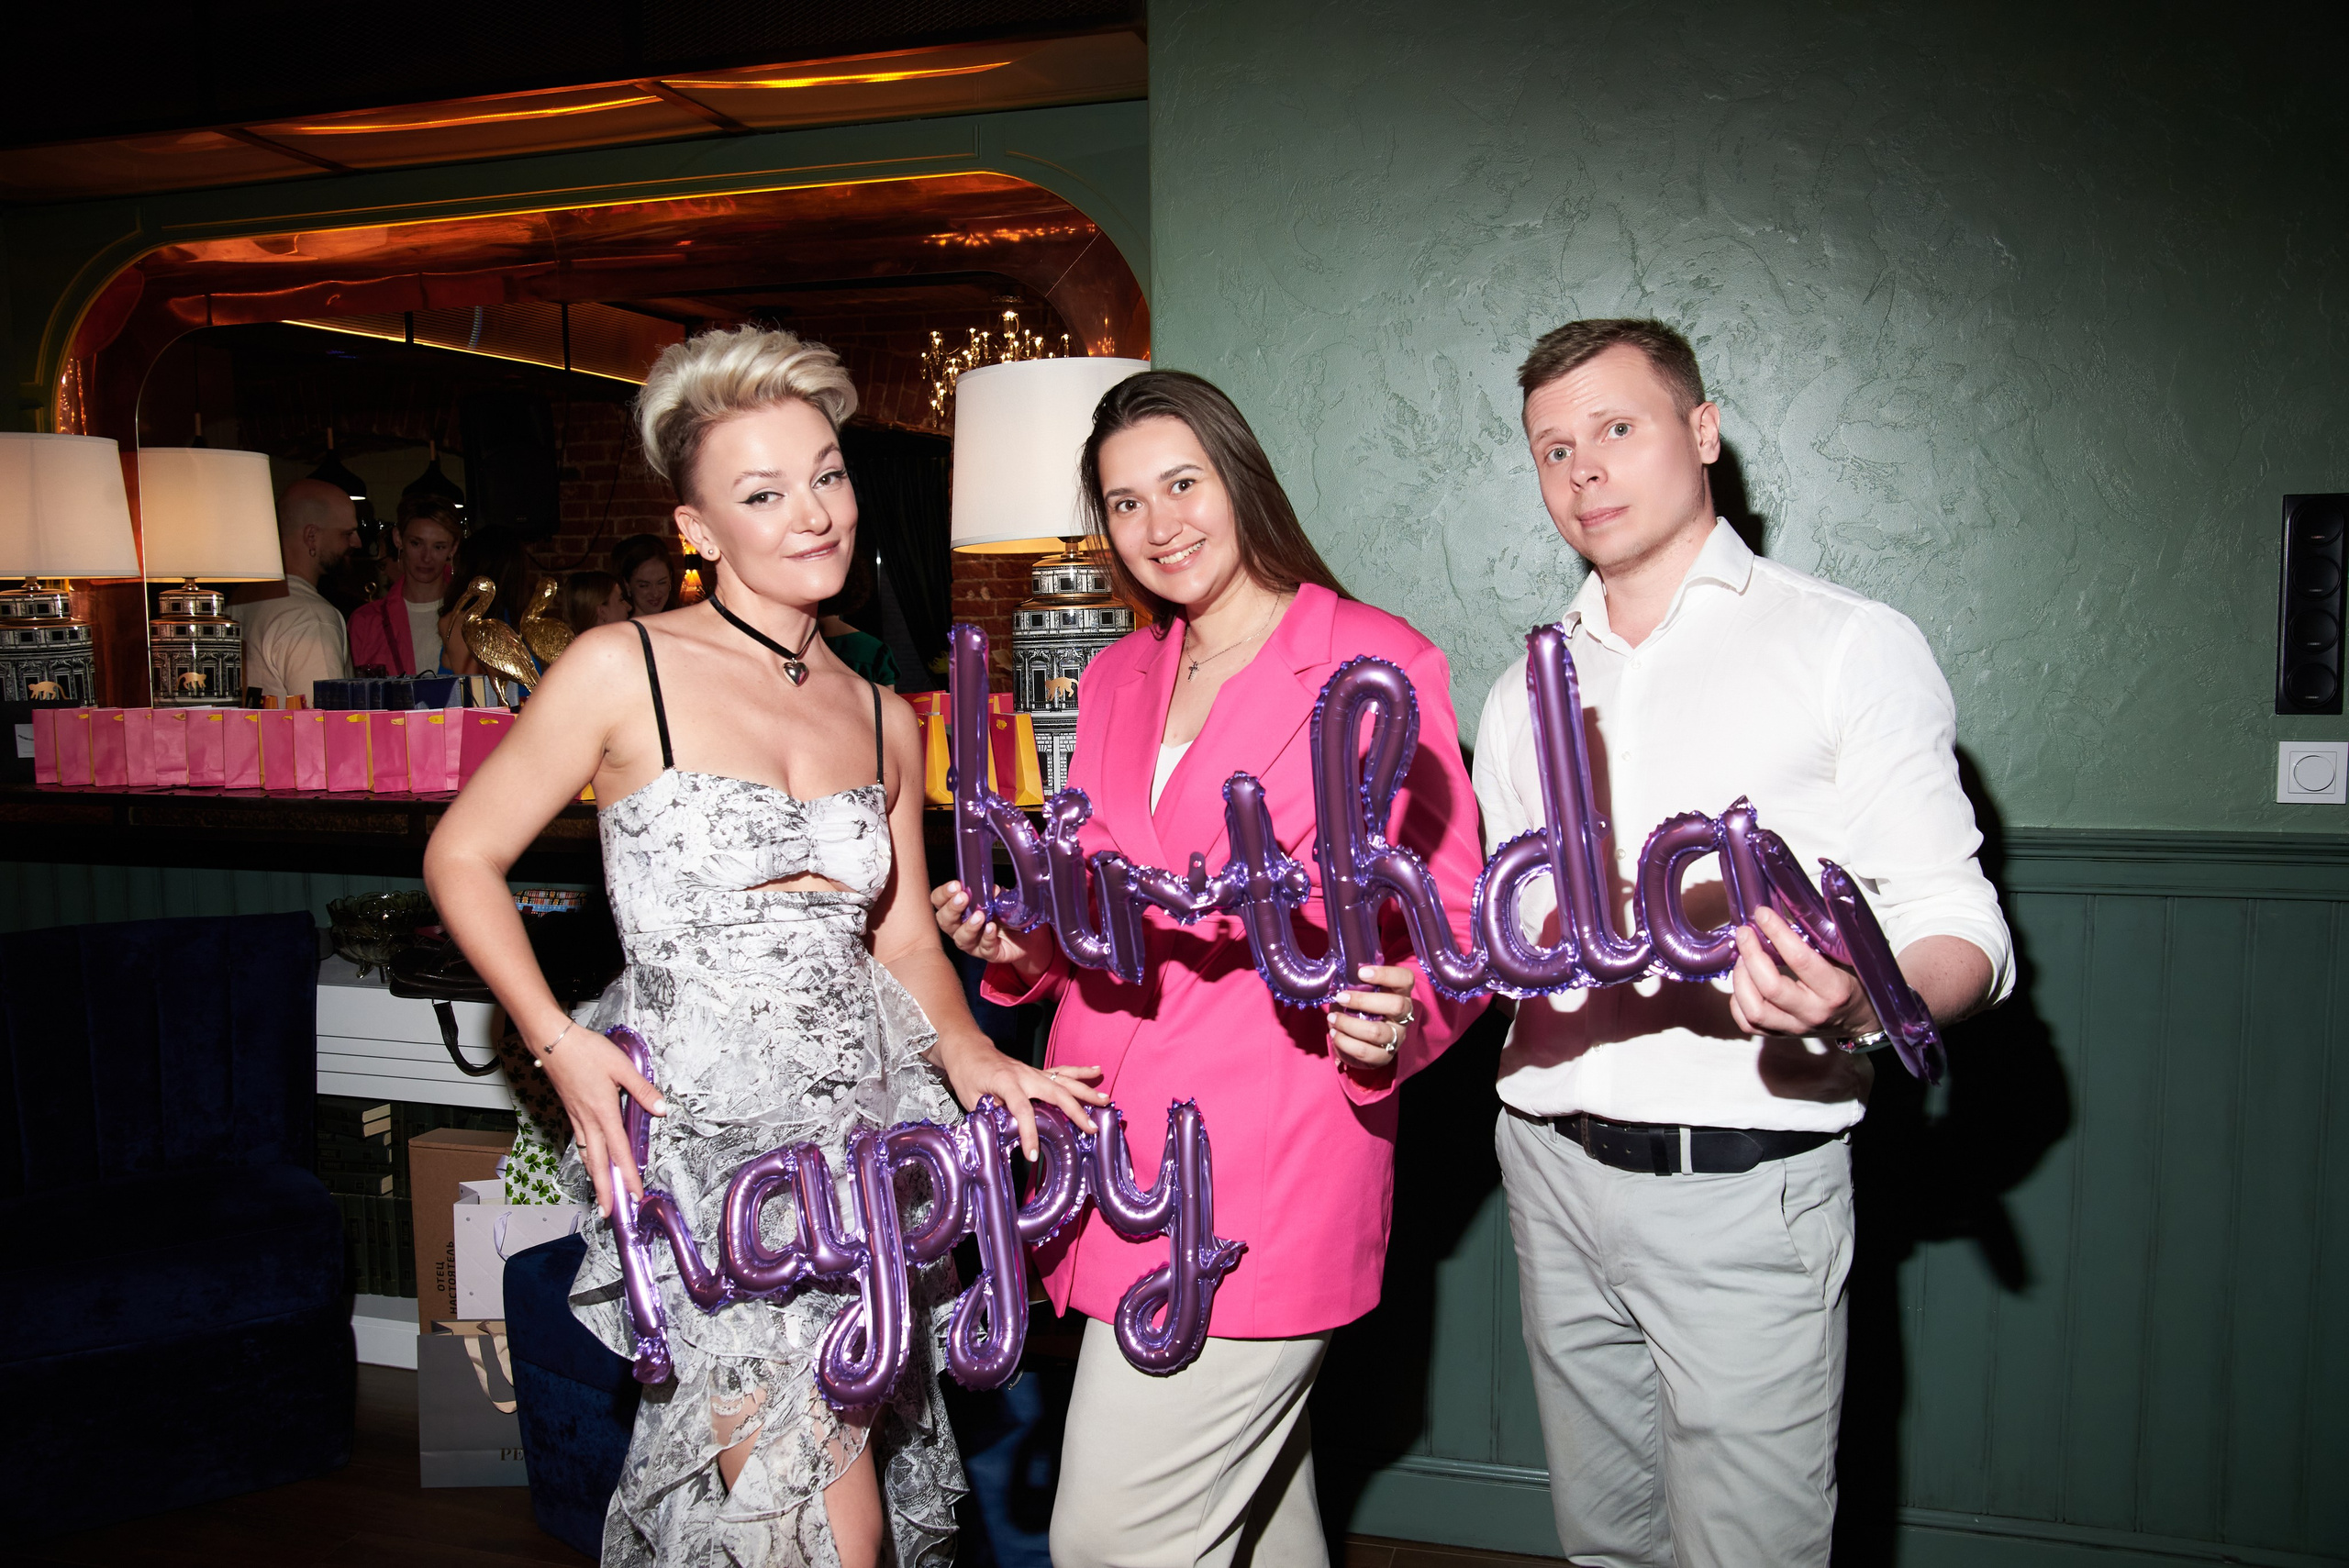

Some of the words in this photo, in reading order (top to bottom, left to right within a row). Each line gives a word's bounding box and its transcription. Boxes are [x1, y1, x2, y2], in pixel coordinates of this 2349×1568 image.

[948, 622, 1943, 1084] birthday
[436, 1262, 445, 1292] ОТЕЦ
[446, 1240, 458, 1315] НАСТОЯТЕЛЬ
[606, 1024, 1248, 1411] happy
